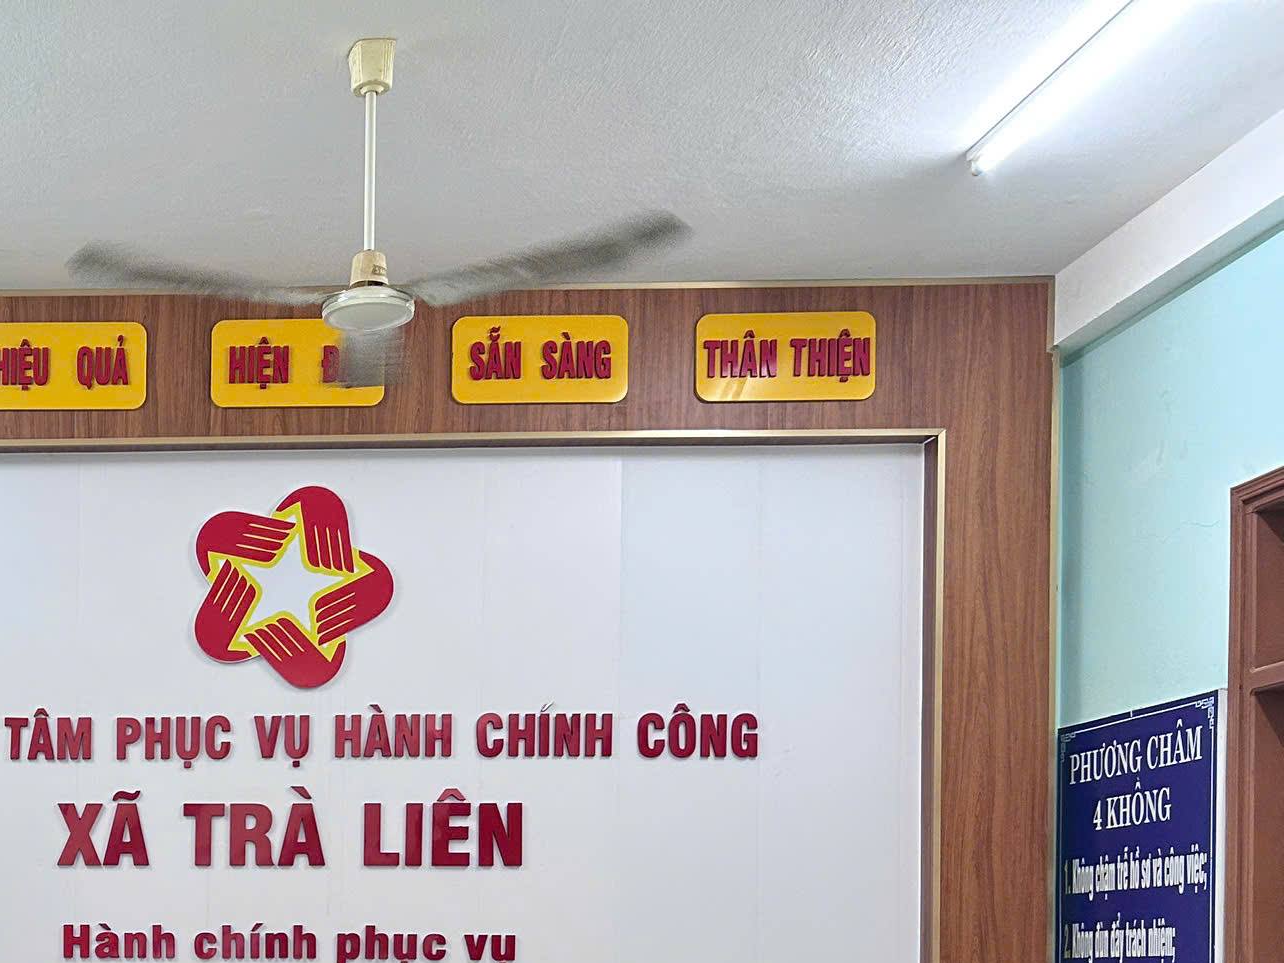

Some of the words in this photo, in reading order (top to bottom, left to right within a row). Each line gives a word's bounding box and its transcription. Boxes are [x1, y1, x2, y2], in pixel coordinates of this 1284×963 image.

[77, 335, 129, 389] QUẢ
[229, 338, 289, 389] HIỆN
[469, 326, 522, 380] SẴN
[541, 332, 611, 380] SÀNG
[704, 330, 777, 378] THÂN
[791, 329, 871, 382] THIỆN
[5, 707, 92, 761] TÂM
[117, 715, 231, 769] PHỤC
[254, 715, 310, 769] VỤ
[334, 704, 452, 758] HÀNH
[476, 702, 613, 758] CHÍNH
[637, 703, 758, 758] CÔNG
[1069, 740, 1141, 785] PHƯƠNG
[1147, 719, 1203, 769] CHÂM
[57, 790, 149, 866] XÃ
[183, 786, 325, 867] TRÀ
[363, 788, 523, 867] LIÊN
[1093, 800, 1102, 830] 4
[1106, 781, 1172, 829] KHÔNG
[1072, 858, 1093, 901] Không
[1152, 848, 1162, 887] và
[1164, 847, 1184, 894] công
[62, 924, 176, 960] Hành
[194, 923, 317, 960] chính
[1125, 919, 1146, 957] trách
